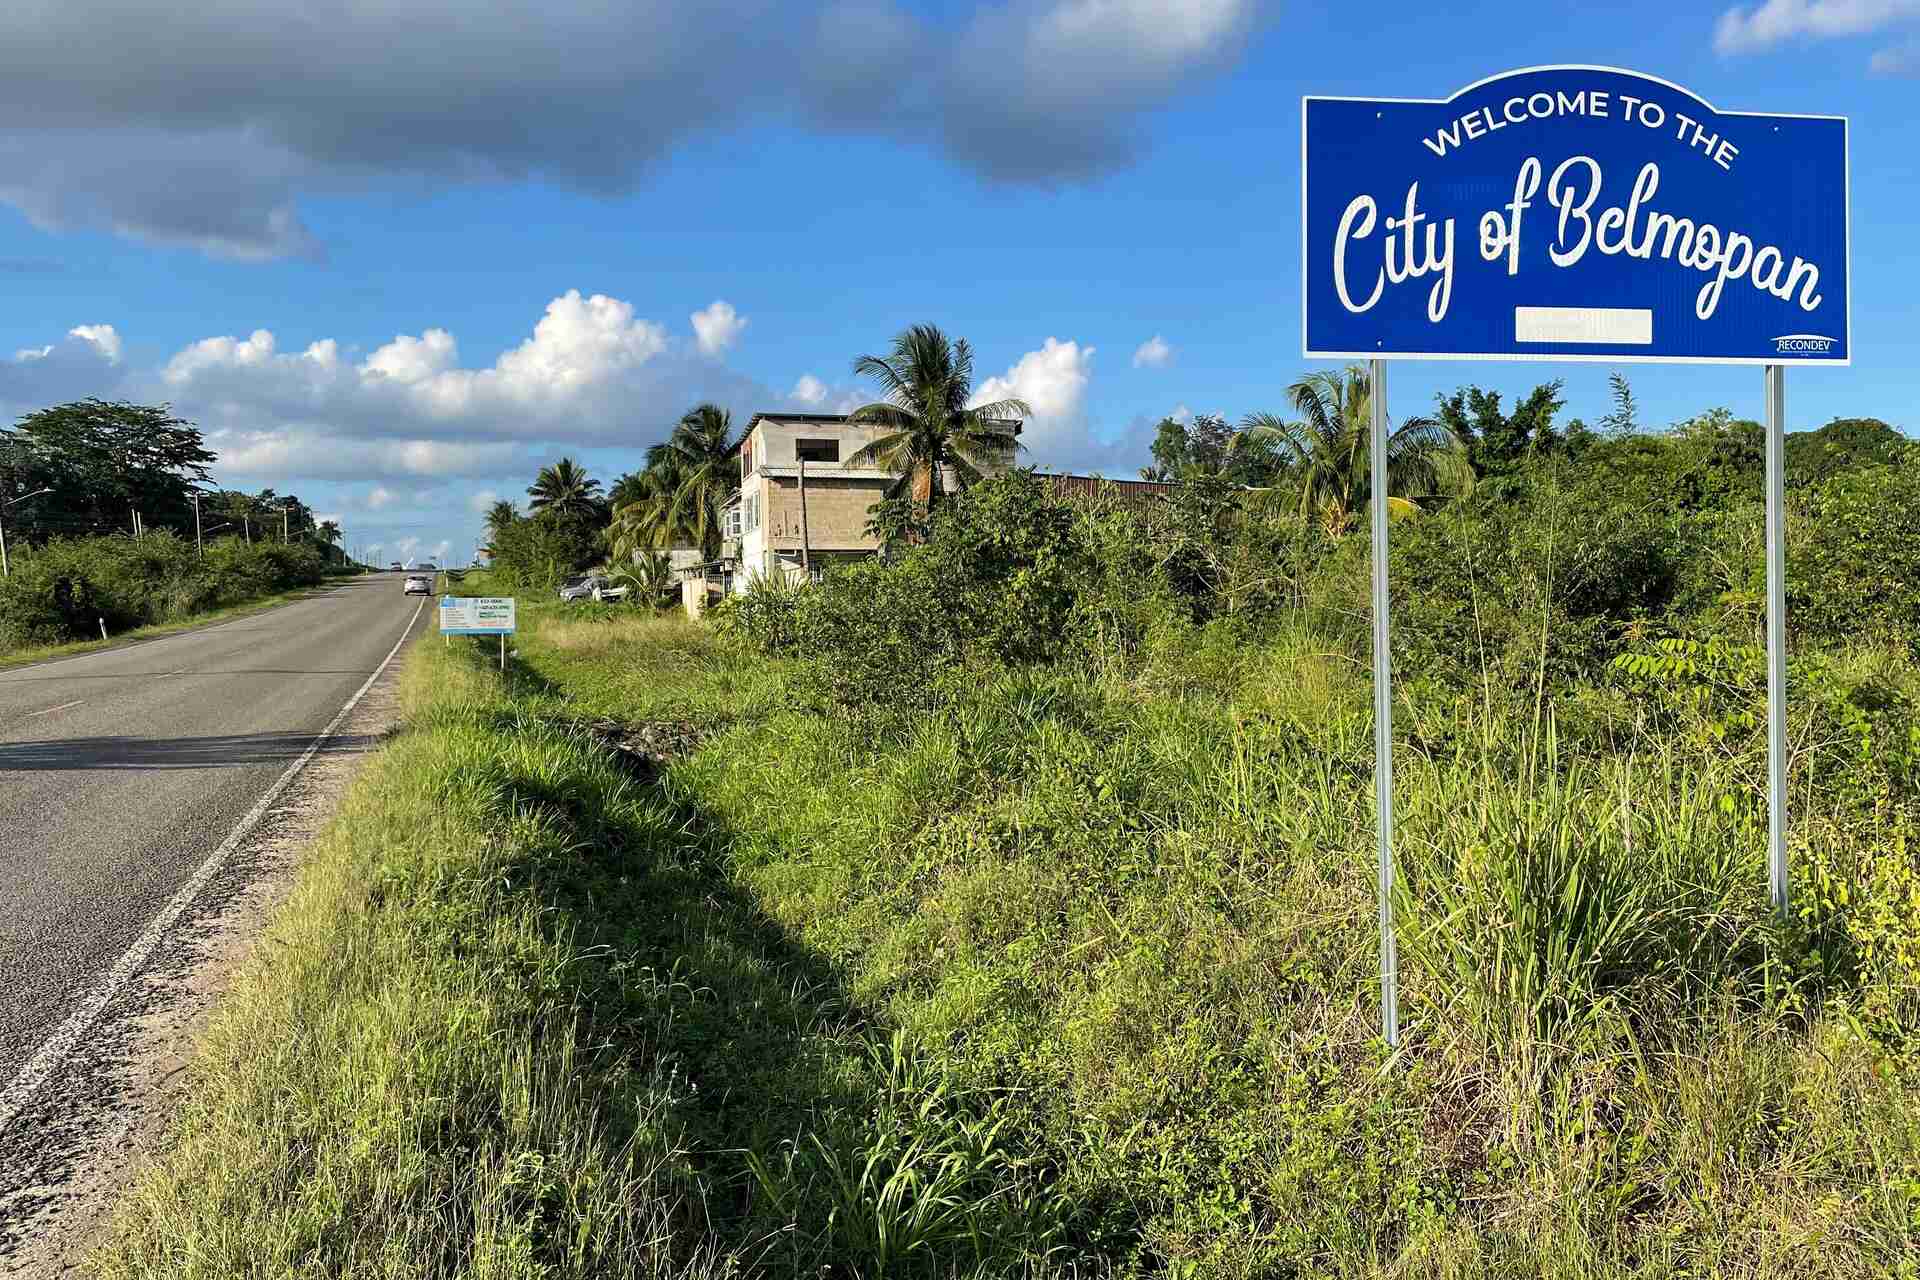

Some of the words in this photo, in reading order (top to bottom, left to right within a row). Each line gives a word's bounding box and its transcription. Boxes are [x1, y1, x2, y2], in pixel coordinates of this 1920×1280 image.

[1422, 90, 1609, 158] WELCOME
[1619, 95, 1665, 129] TO
[1675, 113, 1740, 171] THE
[1333, 180, 1455, 323] City
[1479, 156, 1542, 276] of
[1547, 155, 1822, 321] Belmopan
[1776, 339, 1831, 352] RECONDEV
